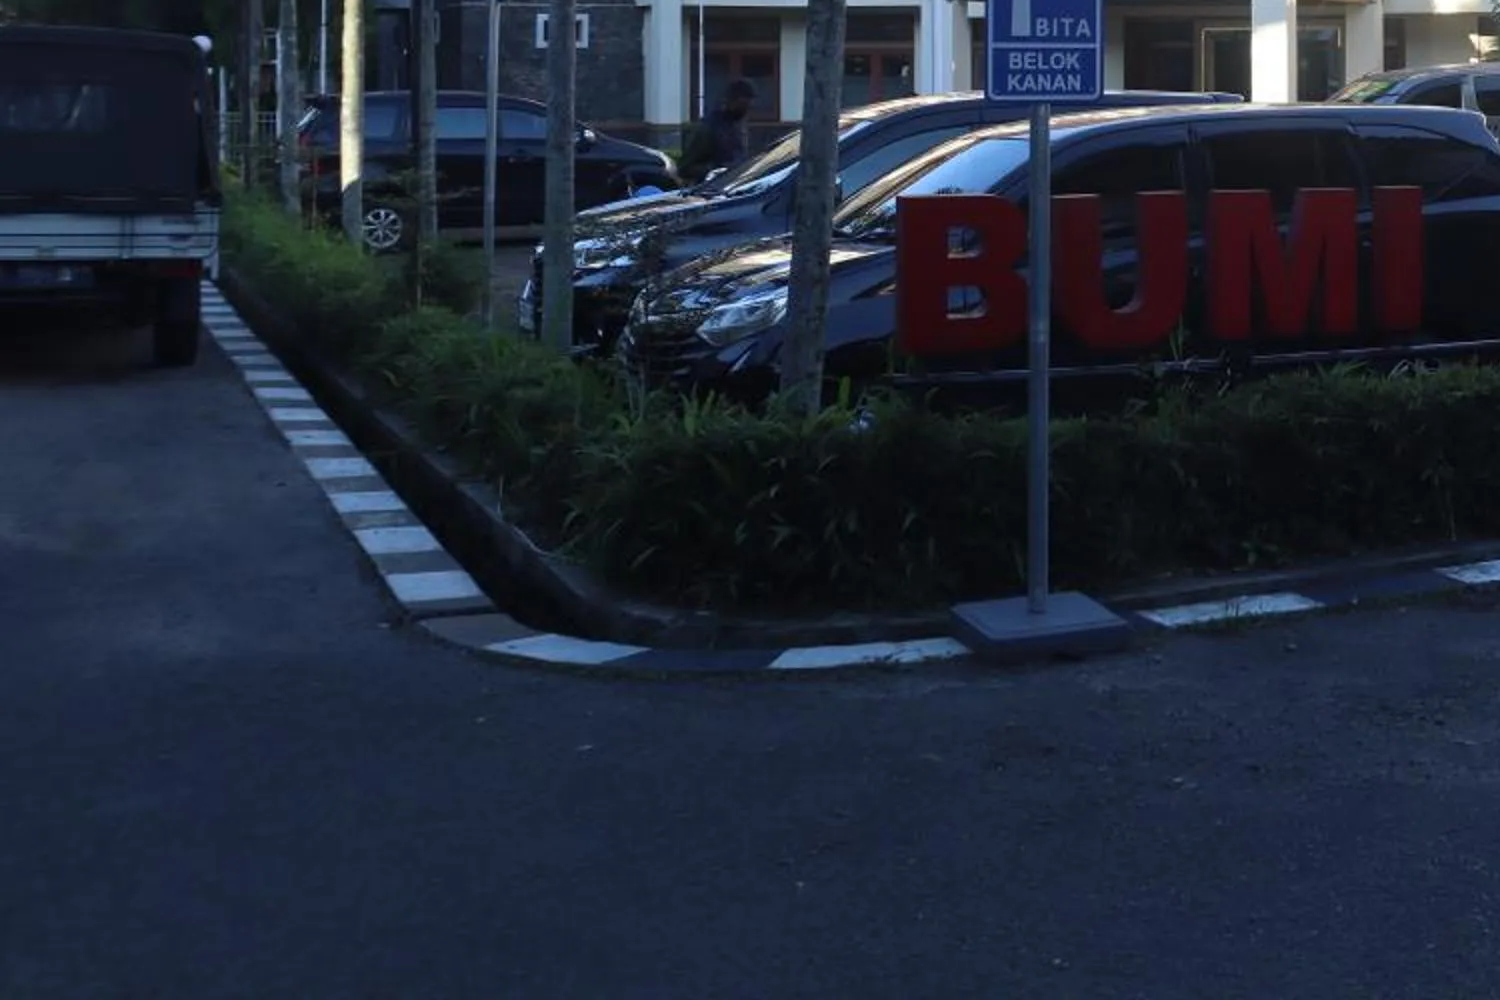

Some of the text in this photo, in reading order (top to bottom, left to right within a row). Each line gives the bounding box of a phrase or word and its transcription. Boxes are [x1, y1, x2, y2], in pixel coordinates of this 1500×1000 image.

[1036, 18, 1091, 37] BITA
[1009, 52, 1081, 70] BELOK
[1008, 73, 1082, 92] KANAN
[897, 186, 1423, 352] BUMI
